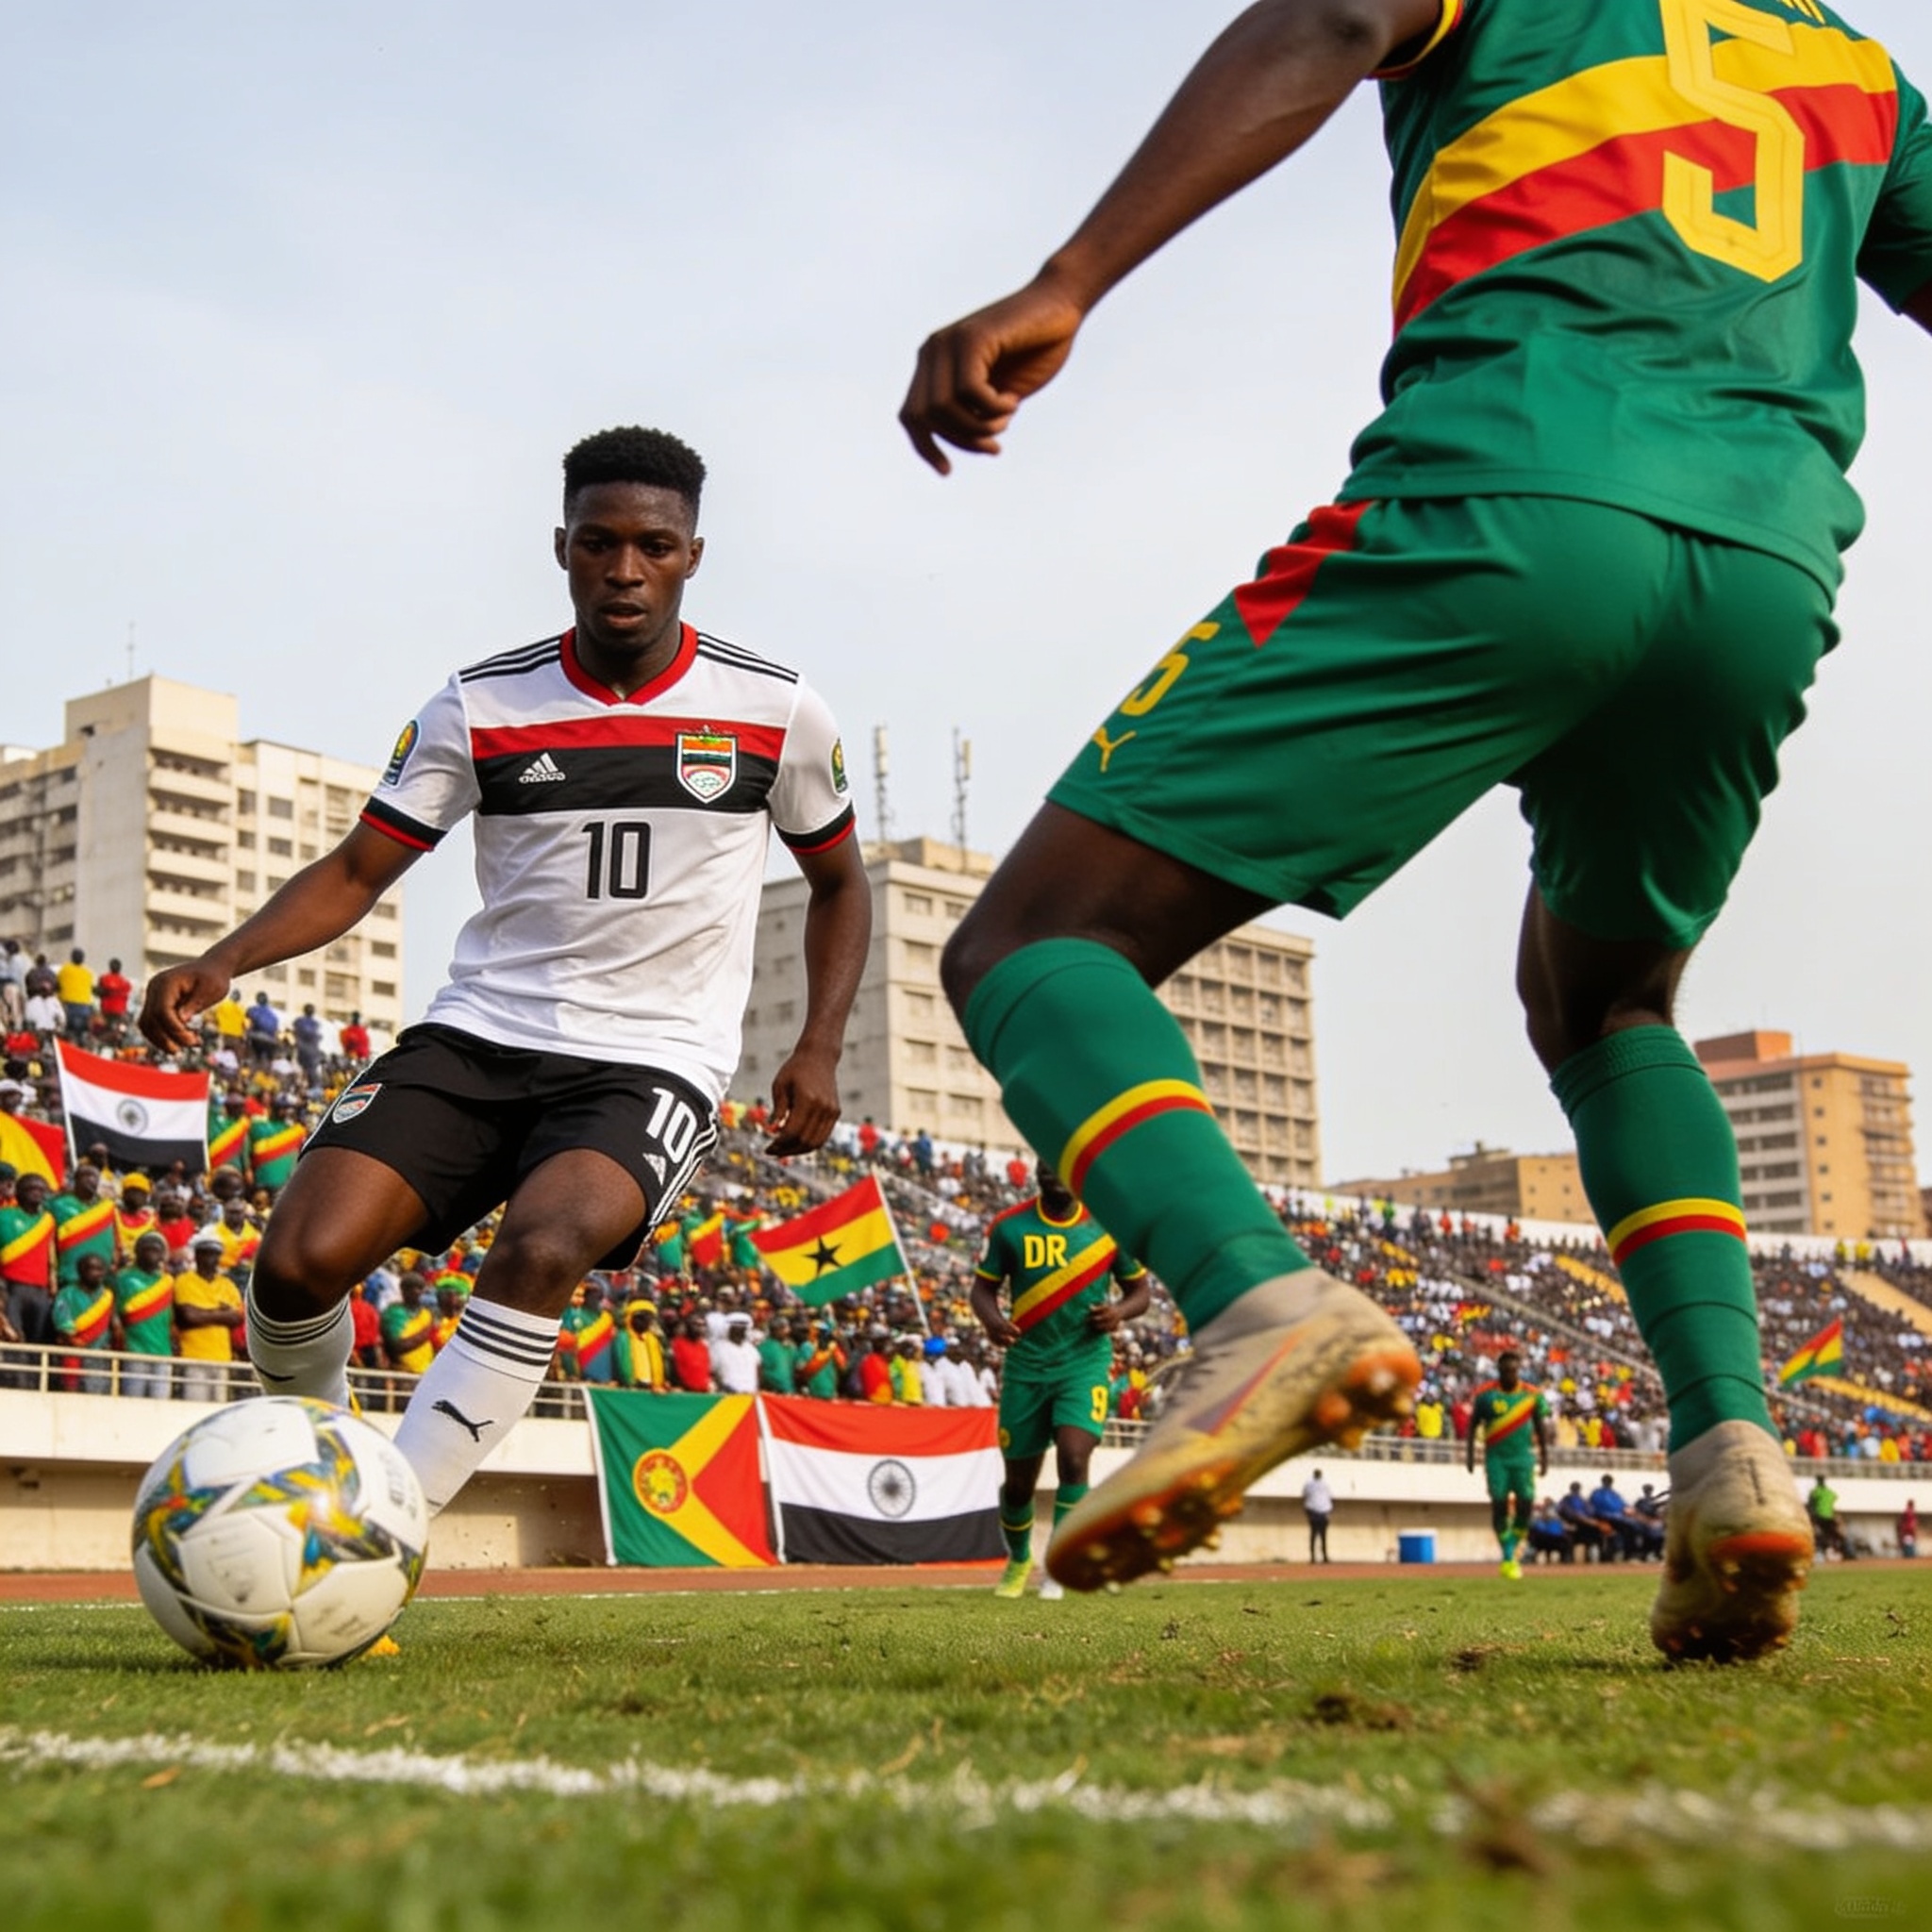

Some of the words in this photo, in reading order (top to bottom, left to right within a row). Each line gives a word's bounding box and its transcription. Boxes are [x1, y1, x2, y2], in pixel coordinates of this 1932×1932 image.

[1659, 0, 1806, 283] 5
[1119, 621, 1221, 717] 5
[581, 821, 652, 900] 10
[645, 1087, 698, 1164] 10
[1024, 1234, 1070, 1269] DR
[1090, 1385, 1109, 1423] 9
